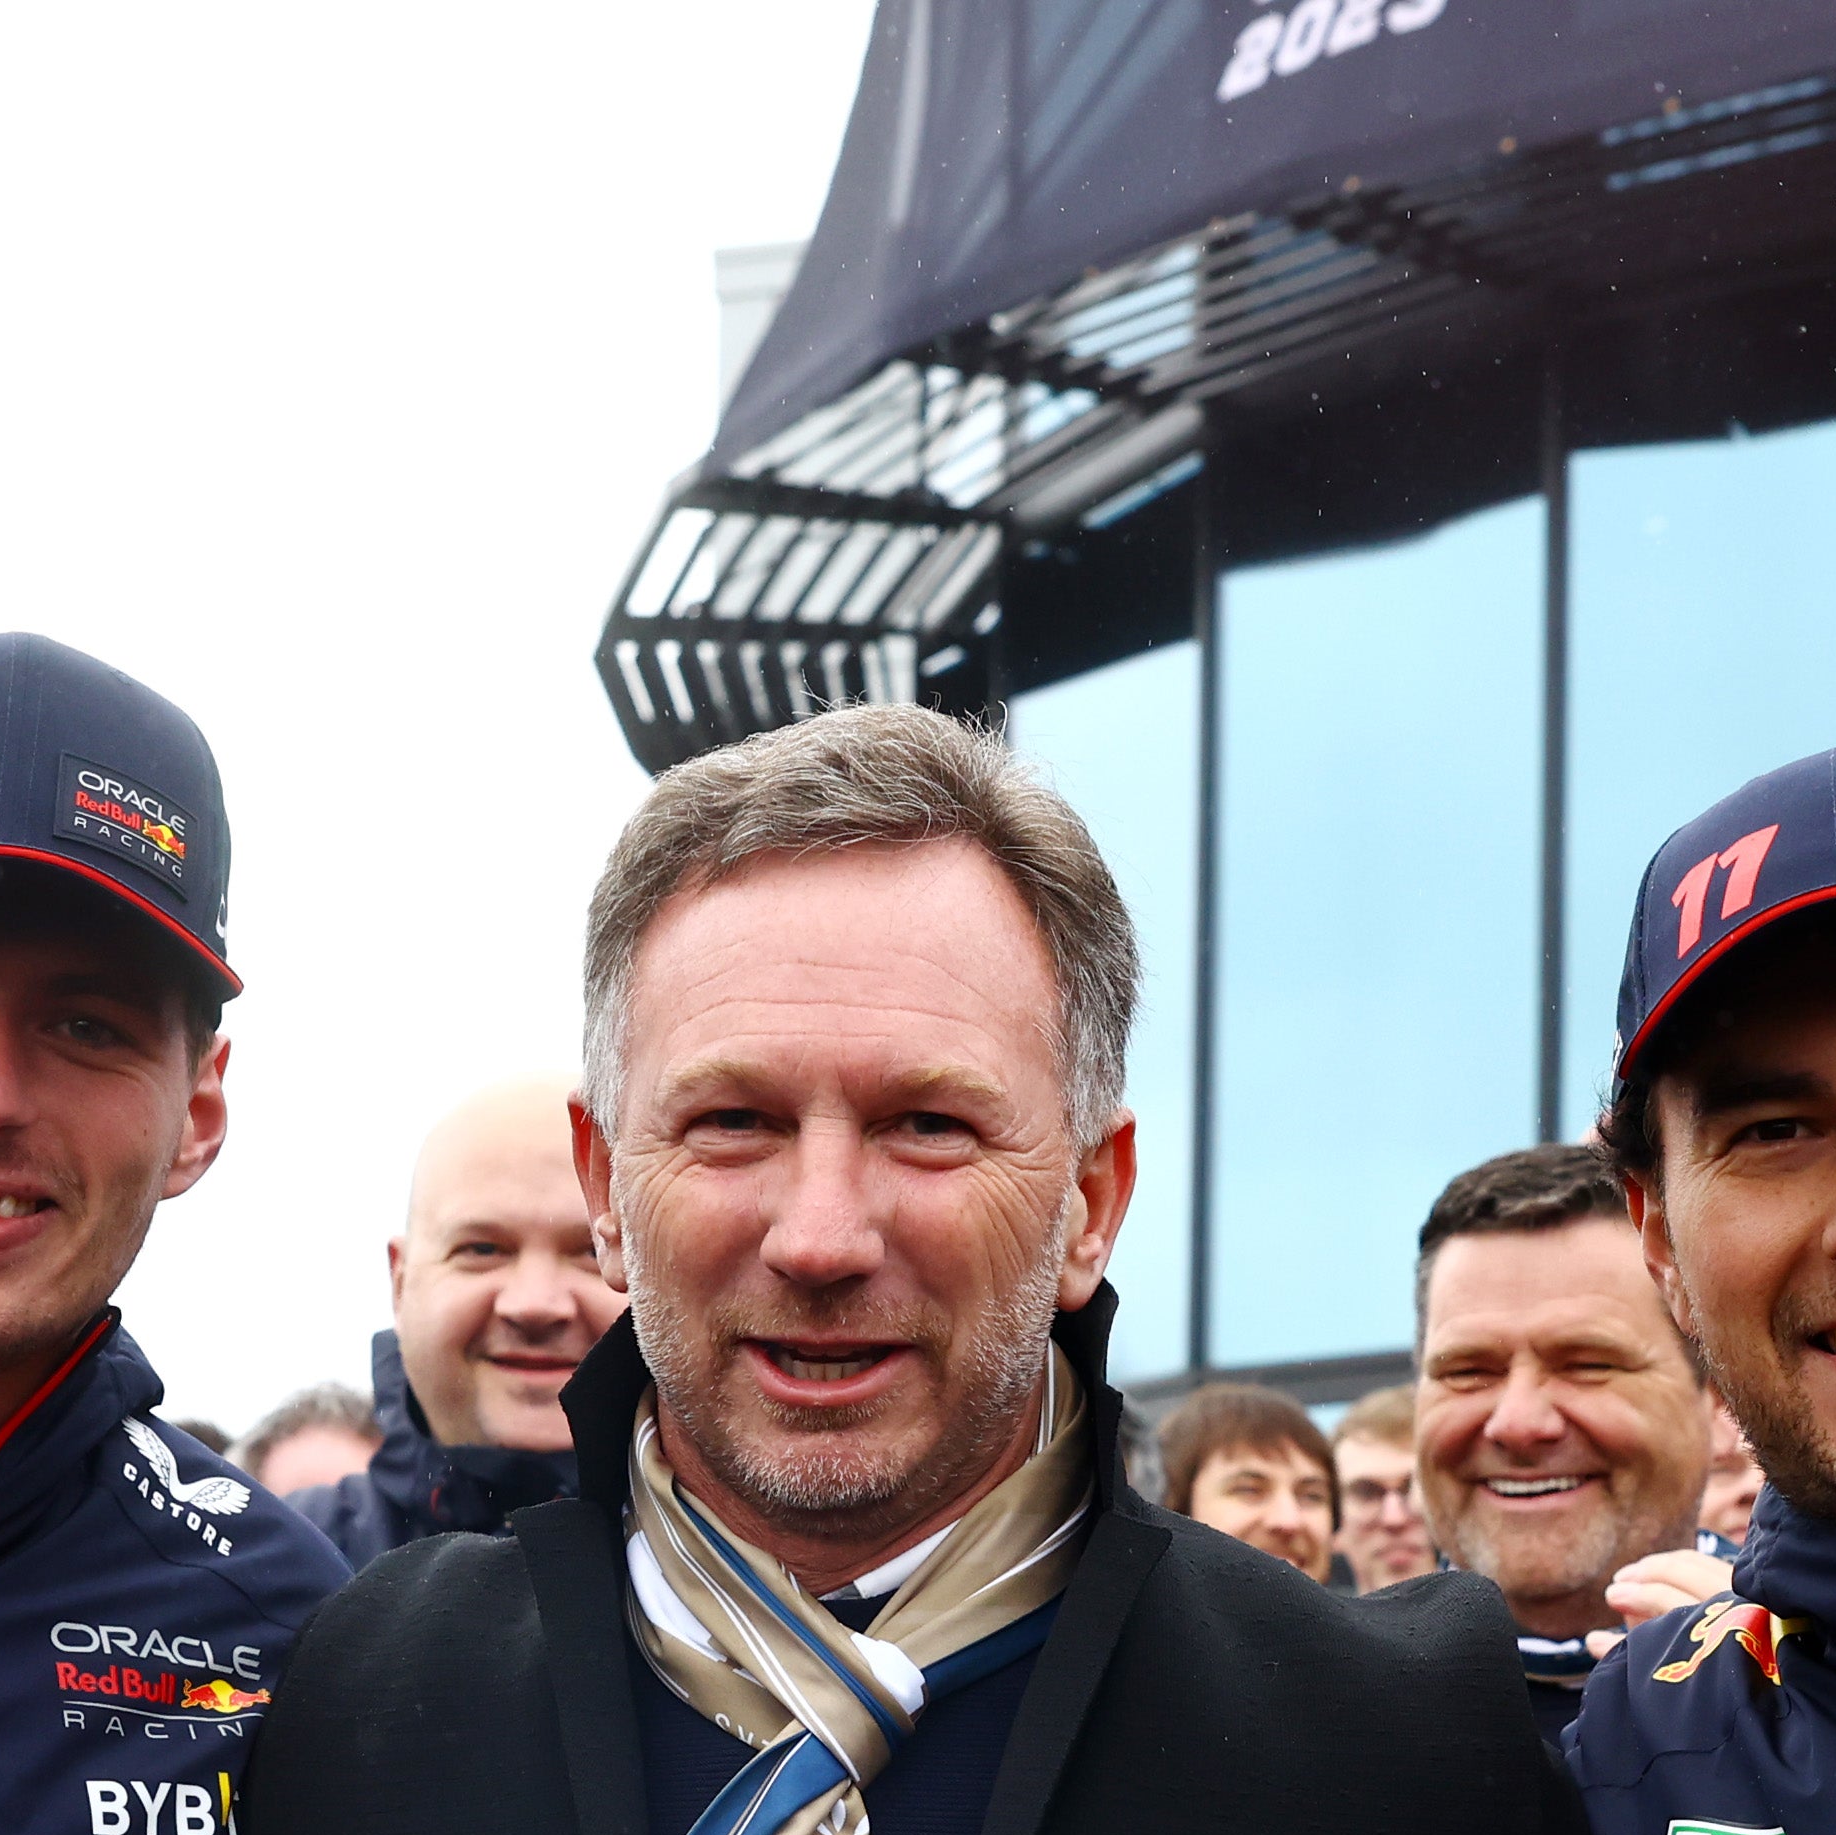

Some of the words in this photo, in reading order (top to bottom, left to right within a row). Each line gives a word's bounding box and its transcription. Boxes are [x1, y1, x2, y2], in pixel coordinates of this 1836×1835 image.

[75, 791, 110, 816] Red
[109, 802, 142, 830] Bull
[77, 770, 186, 836] ORACLE
[73, 816, 182, 877] RACING
[1671, 823, 1779, 960] 11
[122, 1461, 233, 1557] CASTORE
[50, 1621, 262, 1681] ORACLE
[55, 1661, 119, 1695] Red
[122, 1668, 175, 1705] Bull
[63, 1709, 244, 1740] RACIN
